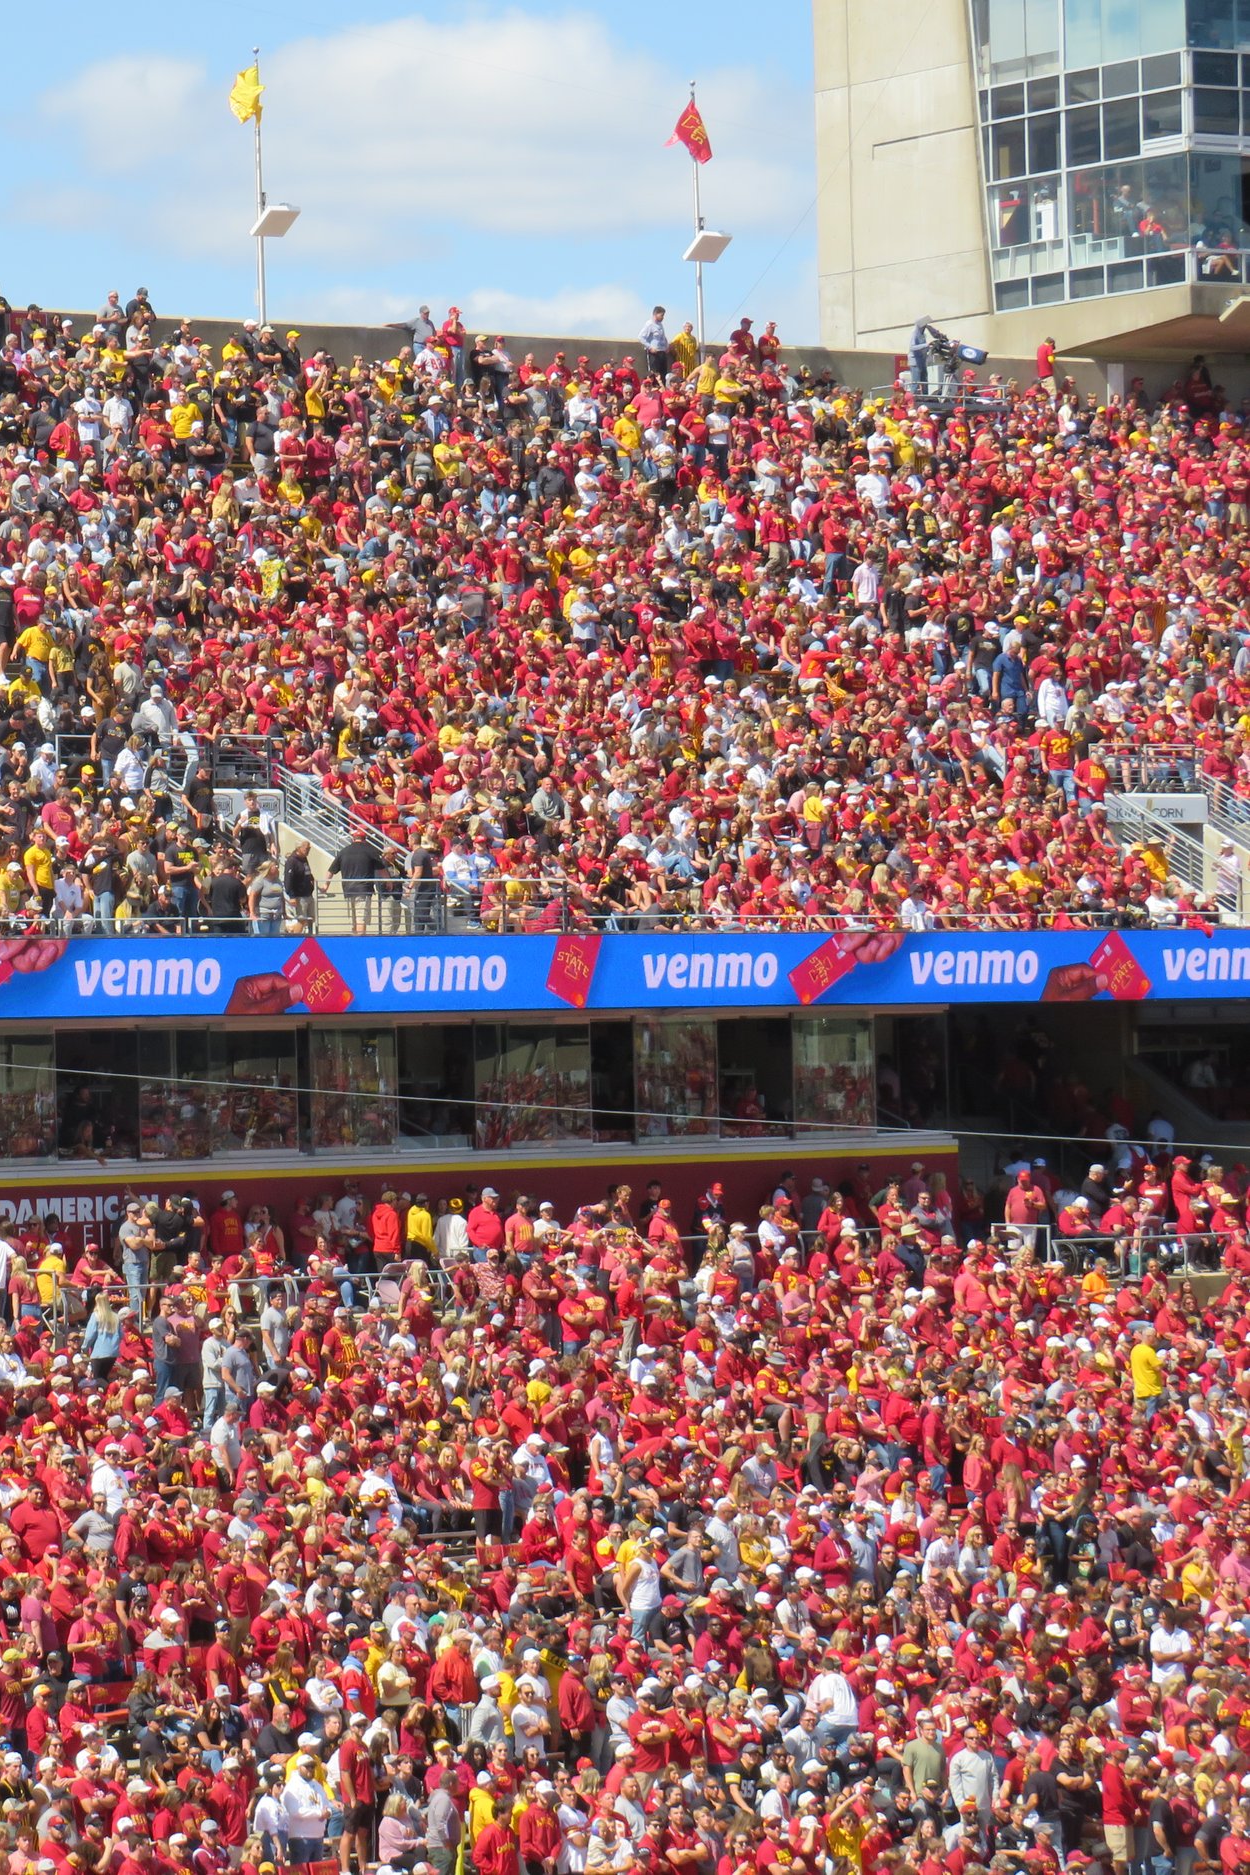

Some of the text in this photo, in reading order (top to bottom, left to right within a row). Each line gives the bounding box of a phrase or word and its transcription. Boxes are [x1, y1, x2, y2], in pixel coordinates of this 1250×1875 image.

[1050, 736, 1071, 755] 22
[1152, 807, 1184, 819] CORN
[74, 958, 221, 997] venmo
[365, 955, 507, 993] venmo
[556, 951, 590, 978] STATE
[642, 952, 778, 989] venmo
[809, 956, 829, 987] STATE
[909, 949, 1039, 985] venmo
[1110, 960, 1134, 992] STATE
[1162, 947, 1250, 981] venm
[306, 969, 335, 1005] STATE
